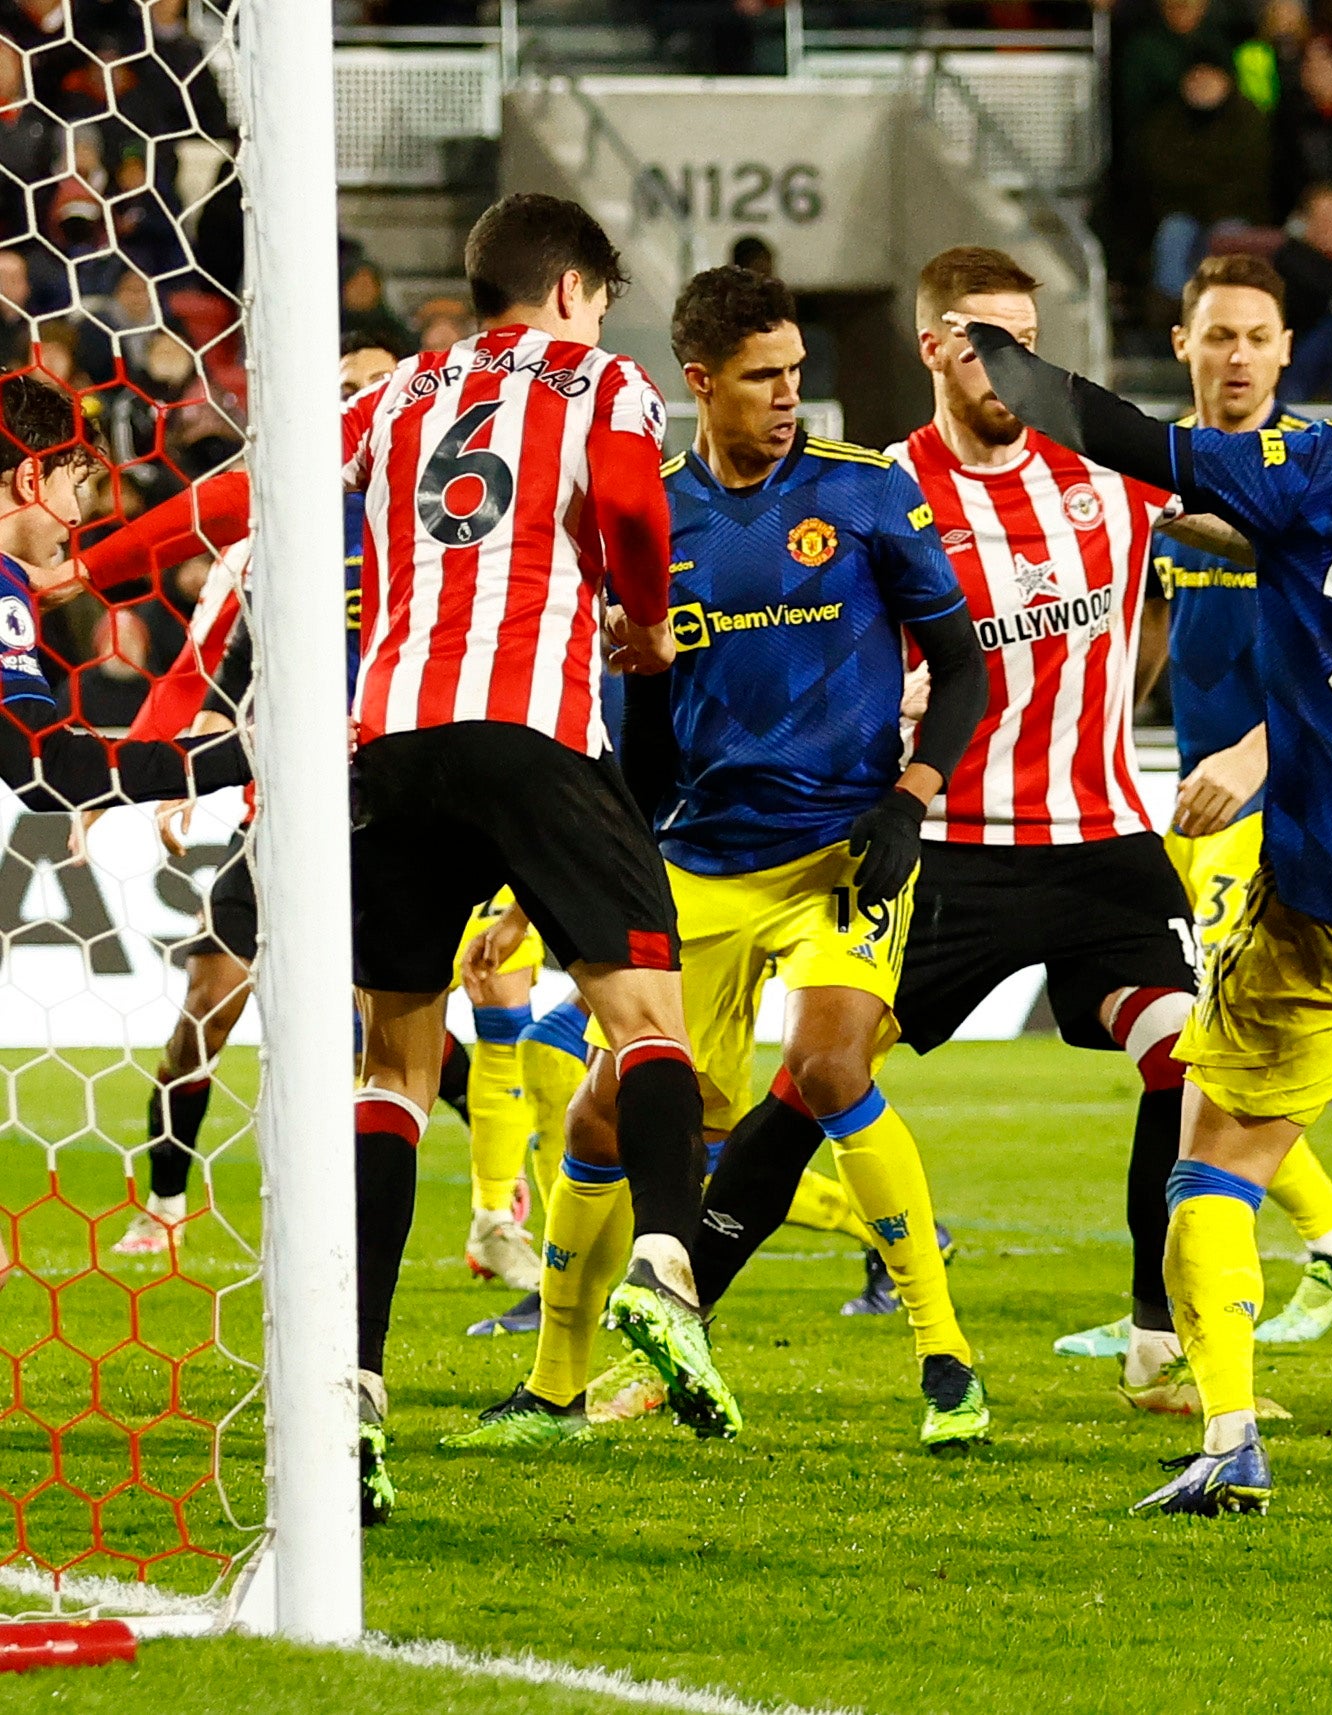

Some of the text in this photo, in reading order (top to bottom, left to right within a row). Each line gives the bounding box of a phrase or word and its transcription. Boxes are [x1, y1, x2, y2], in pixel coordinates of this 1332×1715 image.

[633, 163, 822, 224] N126
[387, 349, 591, 414] ØRGAARD
[417, 400, 515, 546] 6
[1171, 566, 1258, 589] TeamViewe
[706, 602, 843, 633] TeamViewer
[978, 588, 1112, 649] OLLYWOOD
[831, 886, 890, 943] 19
